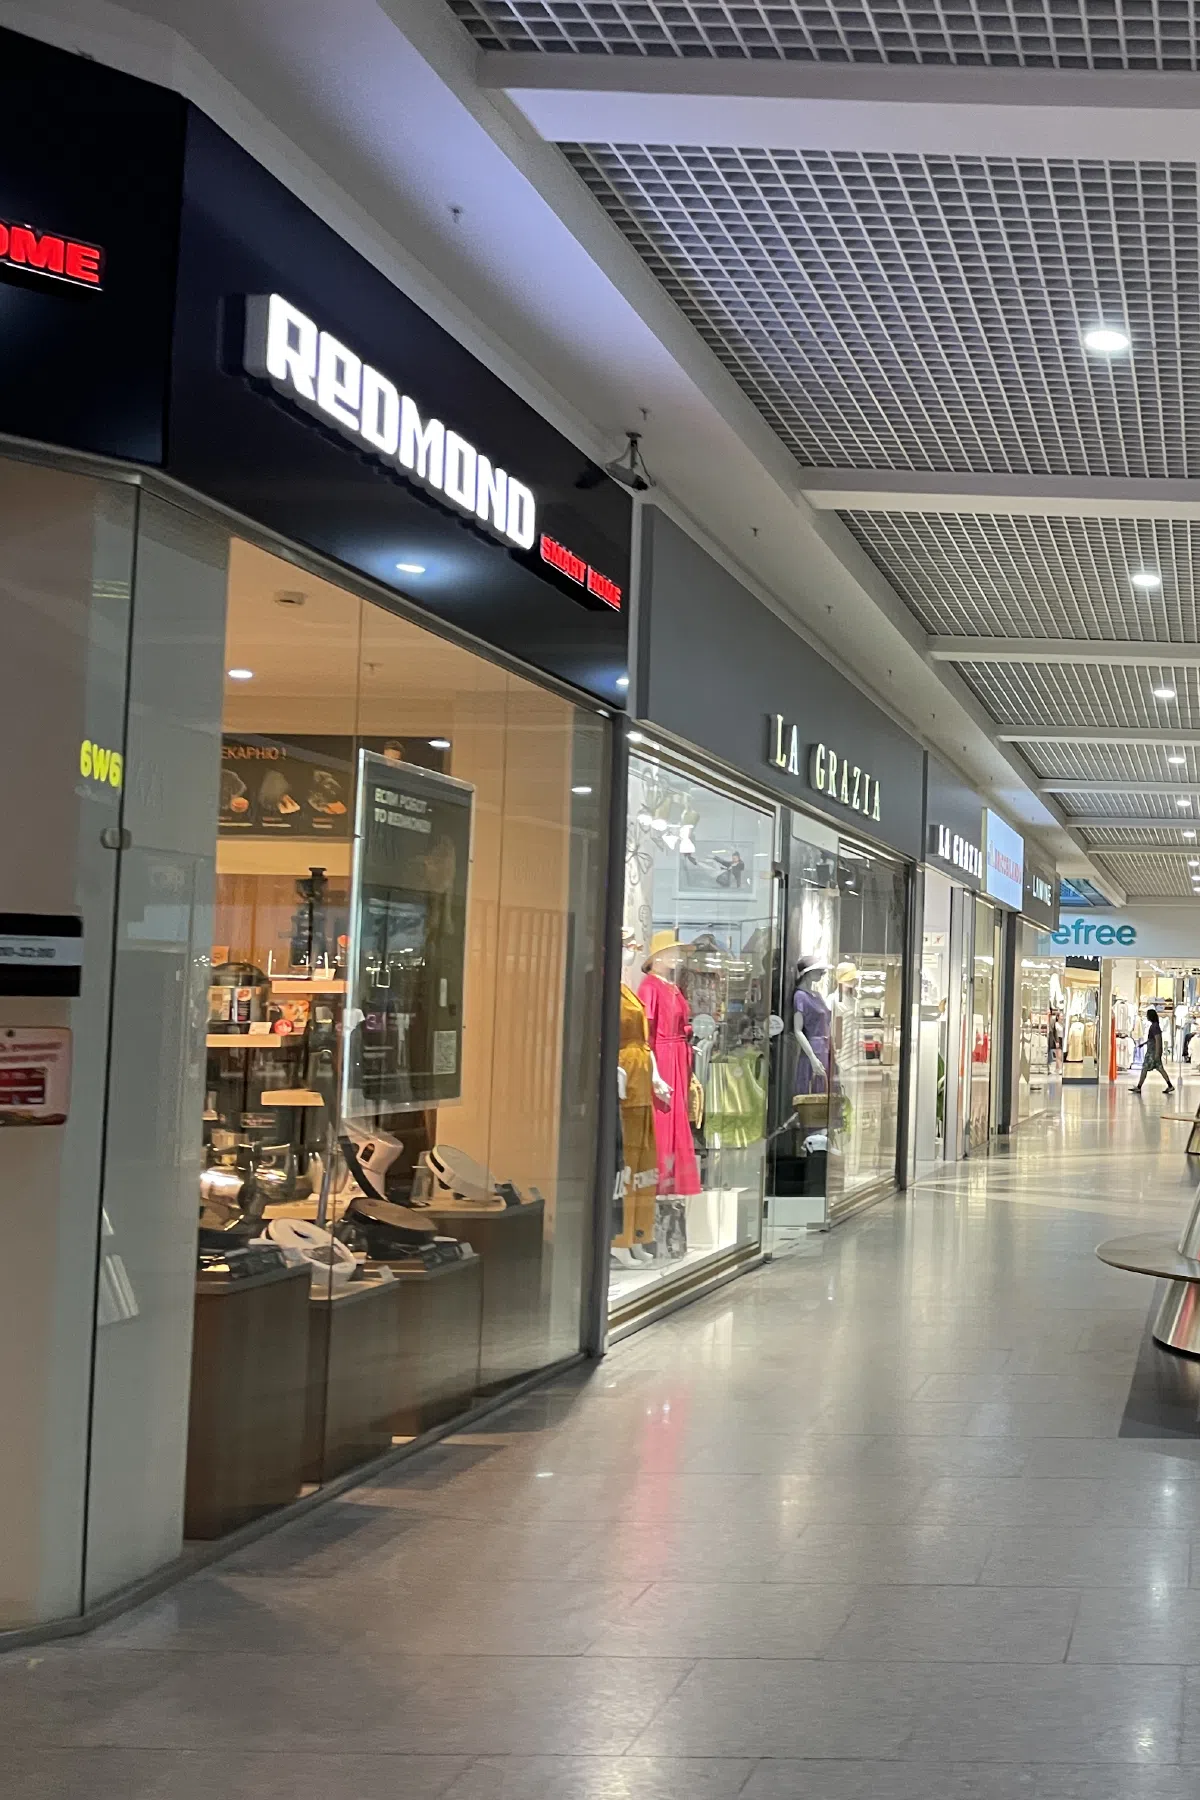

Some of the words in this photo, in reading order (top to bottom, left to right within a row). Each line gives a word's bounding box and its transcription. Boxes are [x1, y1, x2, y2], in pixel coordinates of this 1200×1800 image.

[0, 223, 100, 284] ME
[540, 533, 587, 585] SMART
[587, 566, 622, 609] HOME
[776, 713, 800, 776] LA
[815, 743, 880, 822] GRAZIA
[1051, 918, 1137, 946] efree
